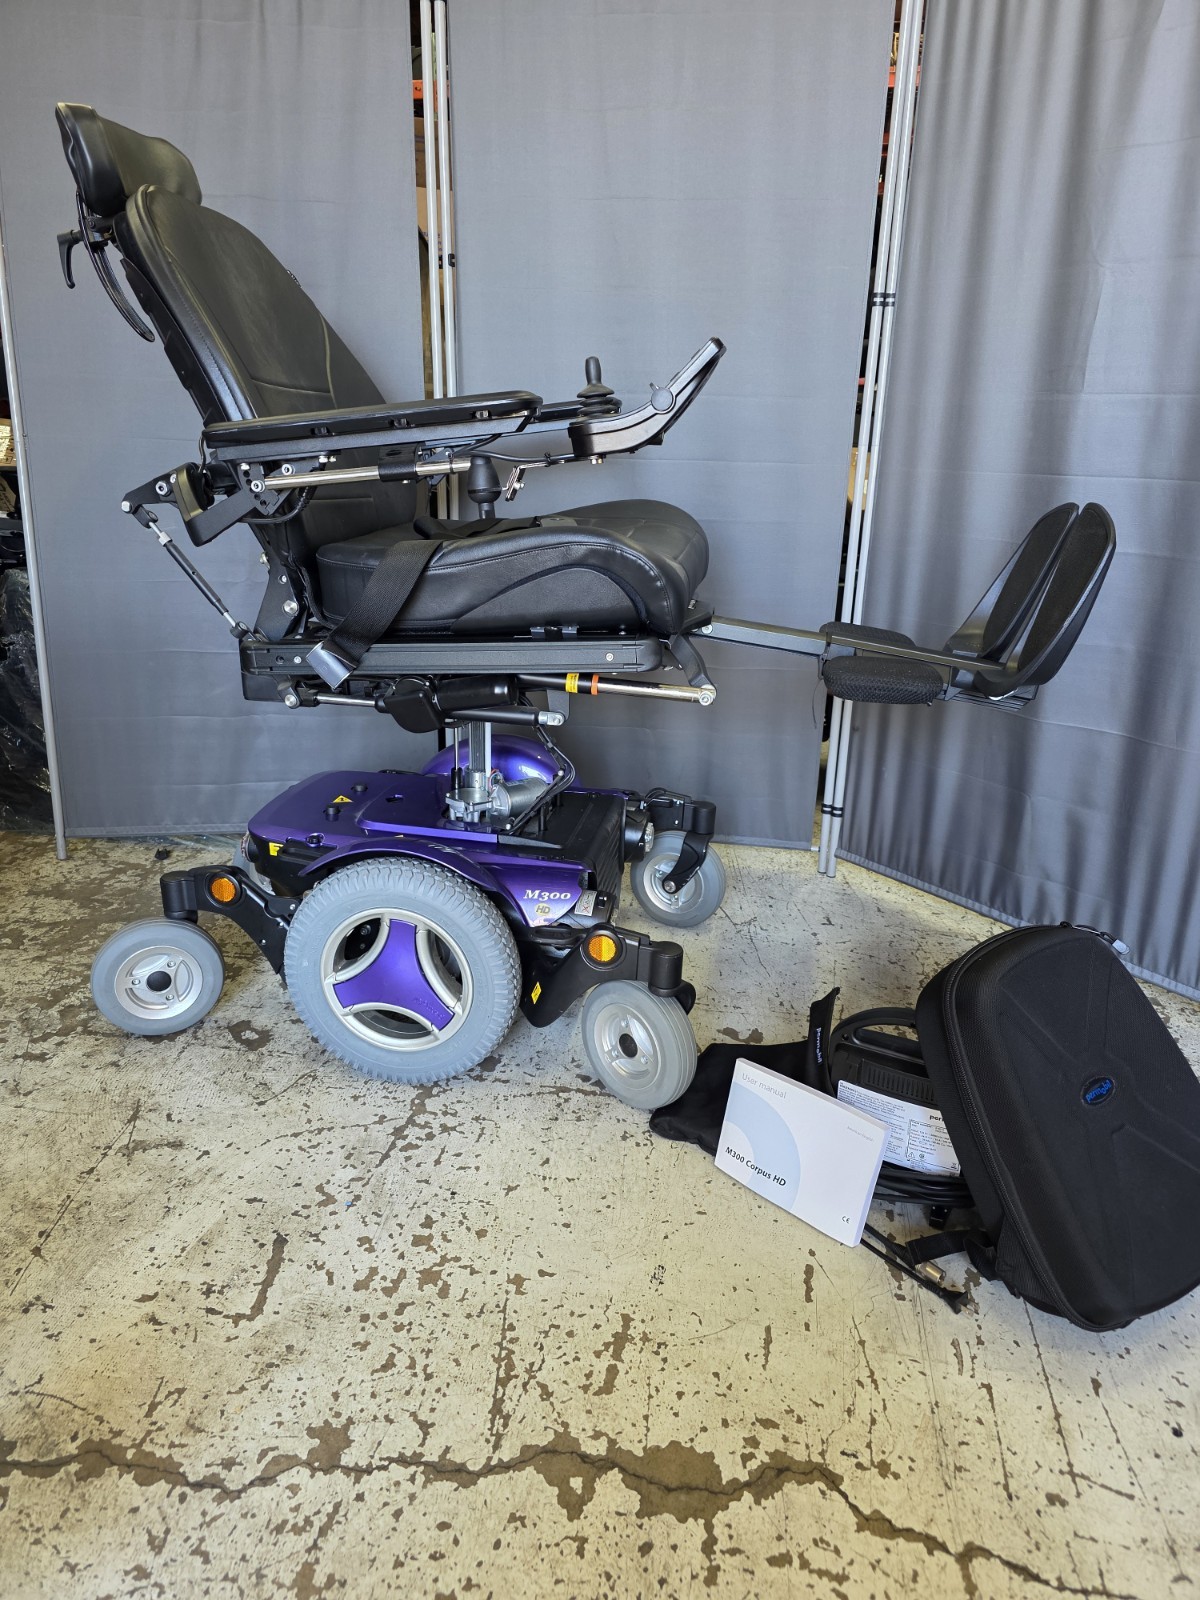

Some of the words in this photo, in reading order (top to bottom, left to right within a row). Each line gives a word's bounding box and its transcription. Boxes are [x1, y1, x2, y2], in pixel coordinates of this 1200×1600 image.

[523, 889, 571, 901] M300
[536, 905, 551, 914] HD
[742, 1073, 757, 1086] User
[758, 1082, 787, 1099] manual
[724, 1146, 745, 1163] M300
[745, 1159, 771, 1181] Corpus
[772, 1174, 787, 1187] HD
